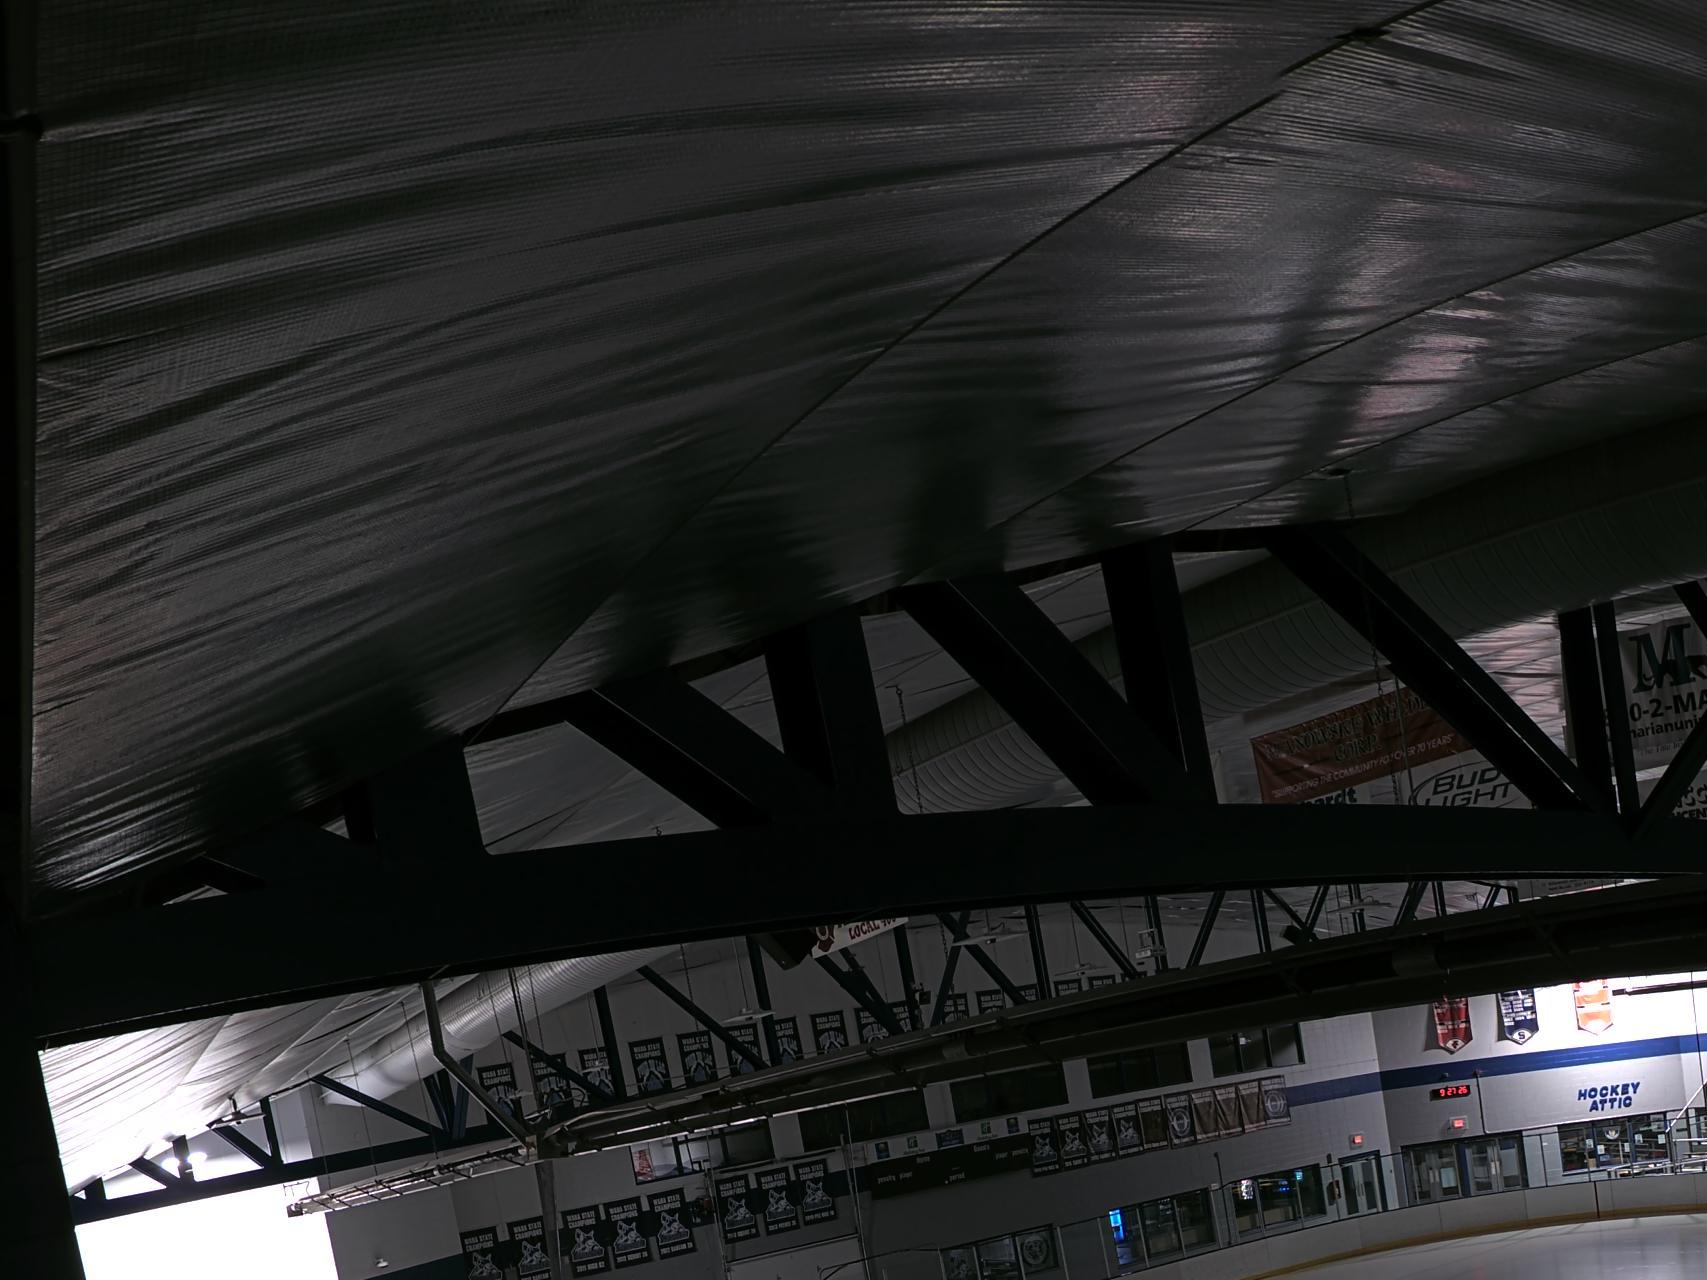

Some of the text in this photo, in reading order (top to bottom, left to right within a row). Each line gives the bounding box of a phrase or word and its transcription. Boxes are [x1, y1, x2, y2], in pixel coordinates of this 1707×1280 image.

[1433, 767, 1502, 795] BUD
[849, 920, 881, 940] LOCAL
[1577, 1082, 1641, 1101] HOCKEY
[1589, 1095, 1633, 1112] ATTIC
